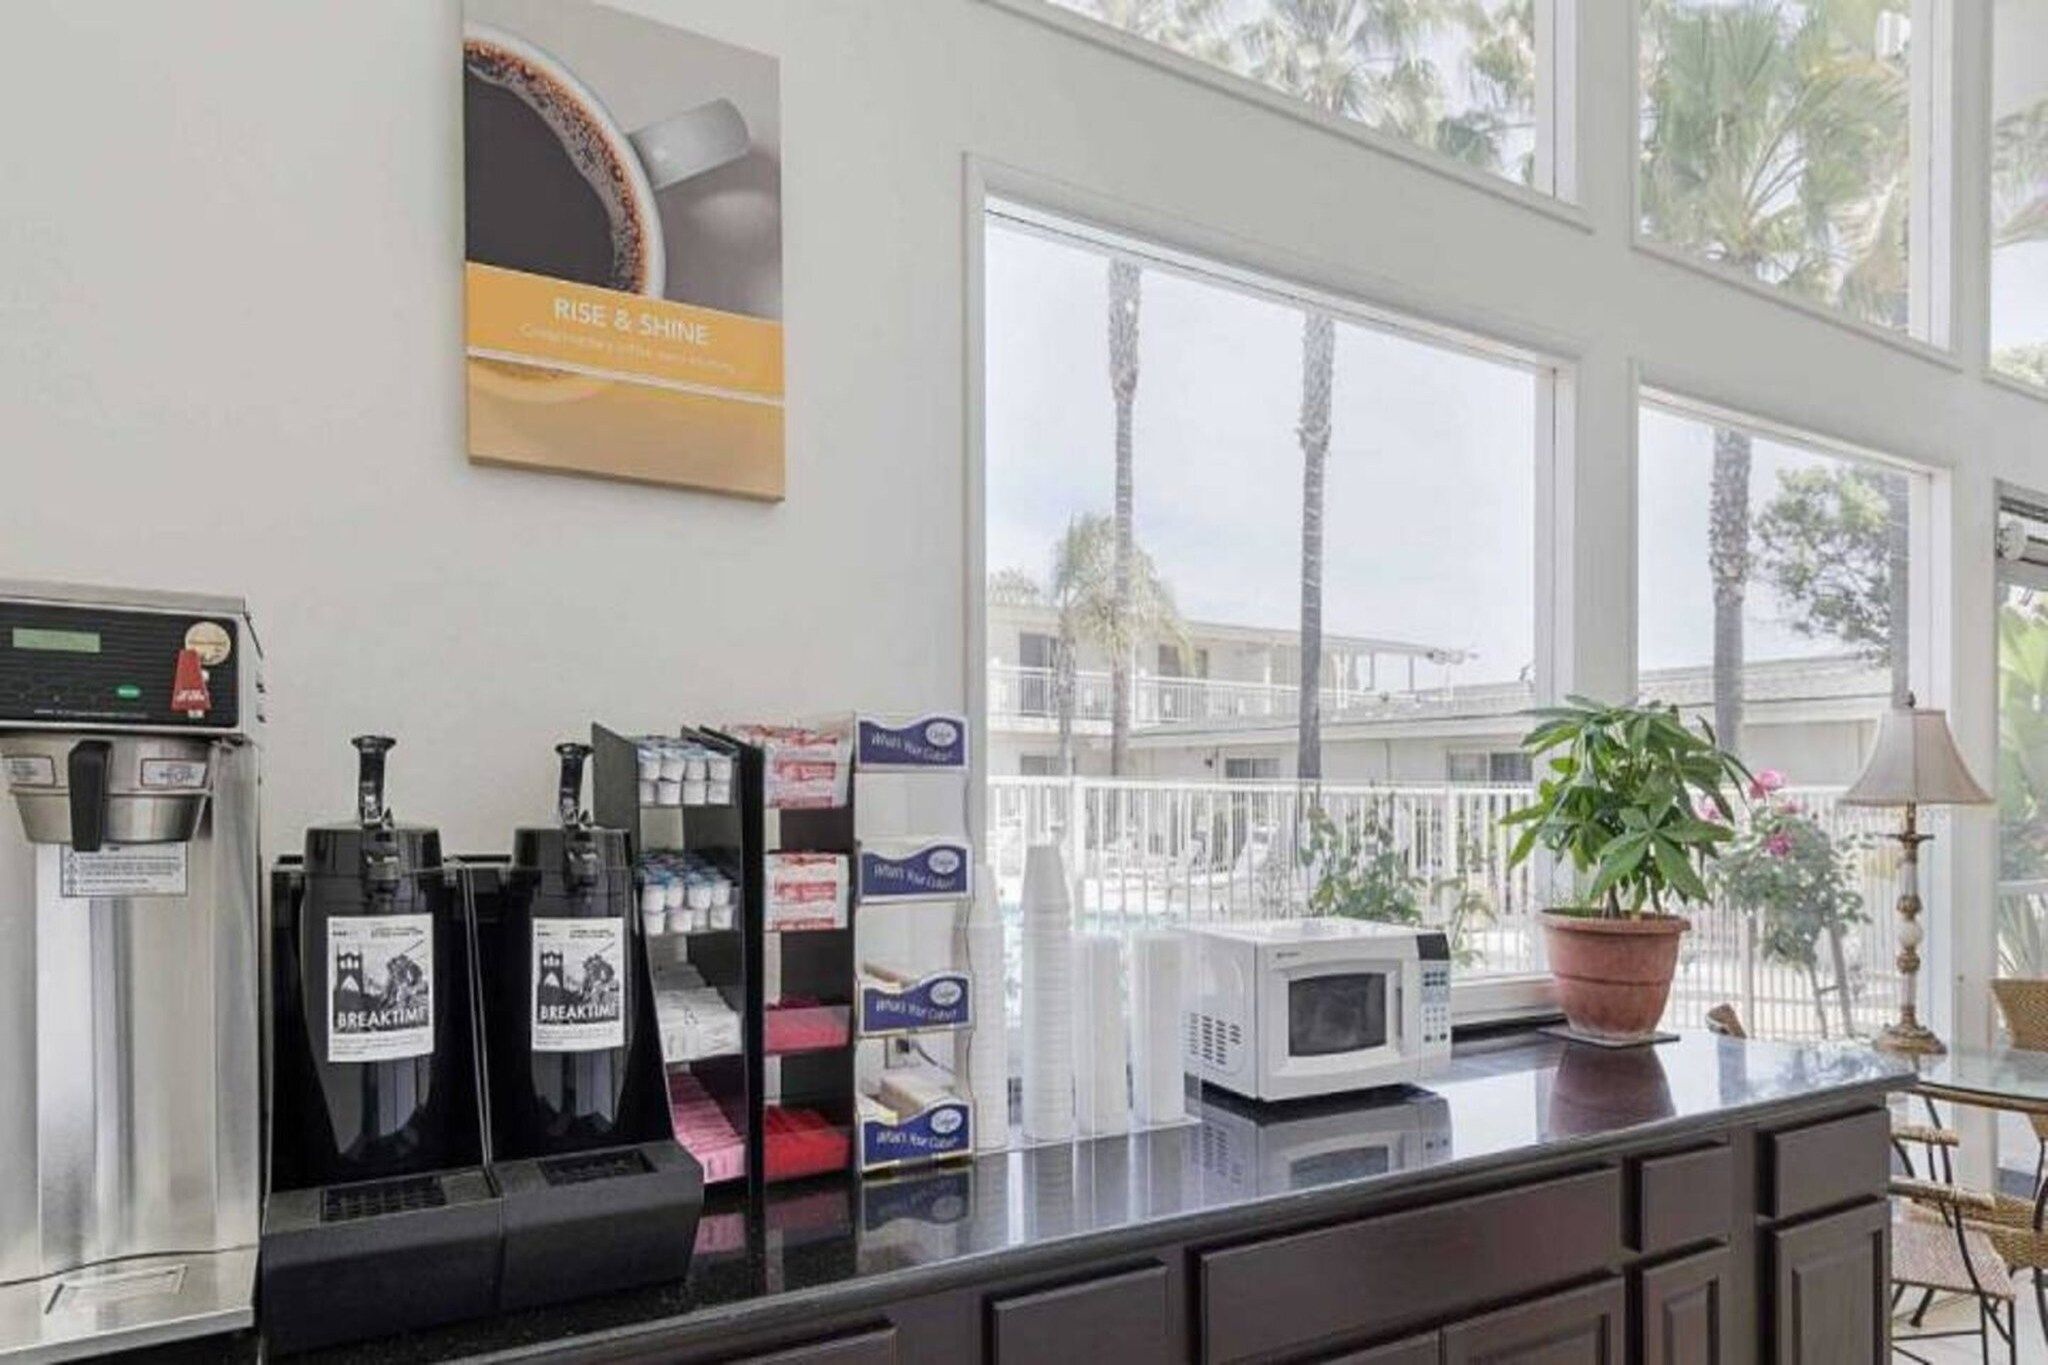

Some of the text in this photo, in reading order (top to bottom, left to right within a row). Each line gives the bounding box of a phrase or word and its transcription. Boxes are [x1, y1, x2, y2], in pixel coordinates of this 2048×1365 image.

[554, 297, 710, 346] RISE & SHINE
[337, 1003, 428, 1030] BREAKTIME
[540, 1000, 619, 1022] BREAKTIME
